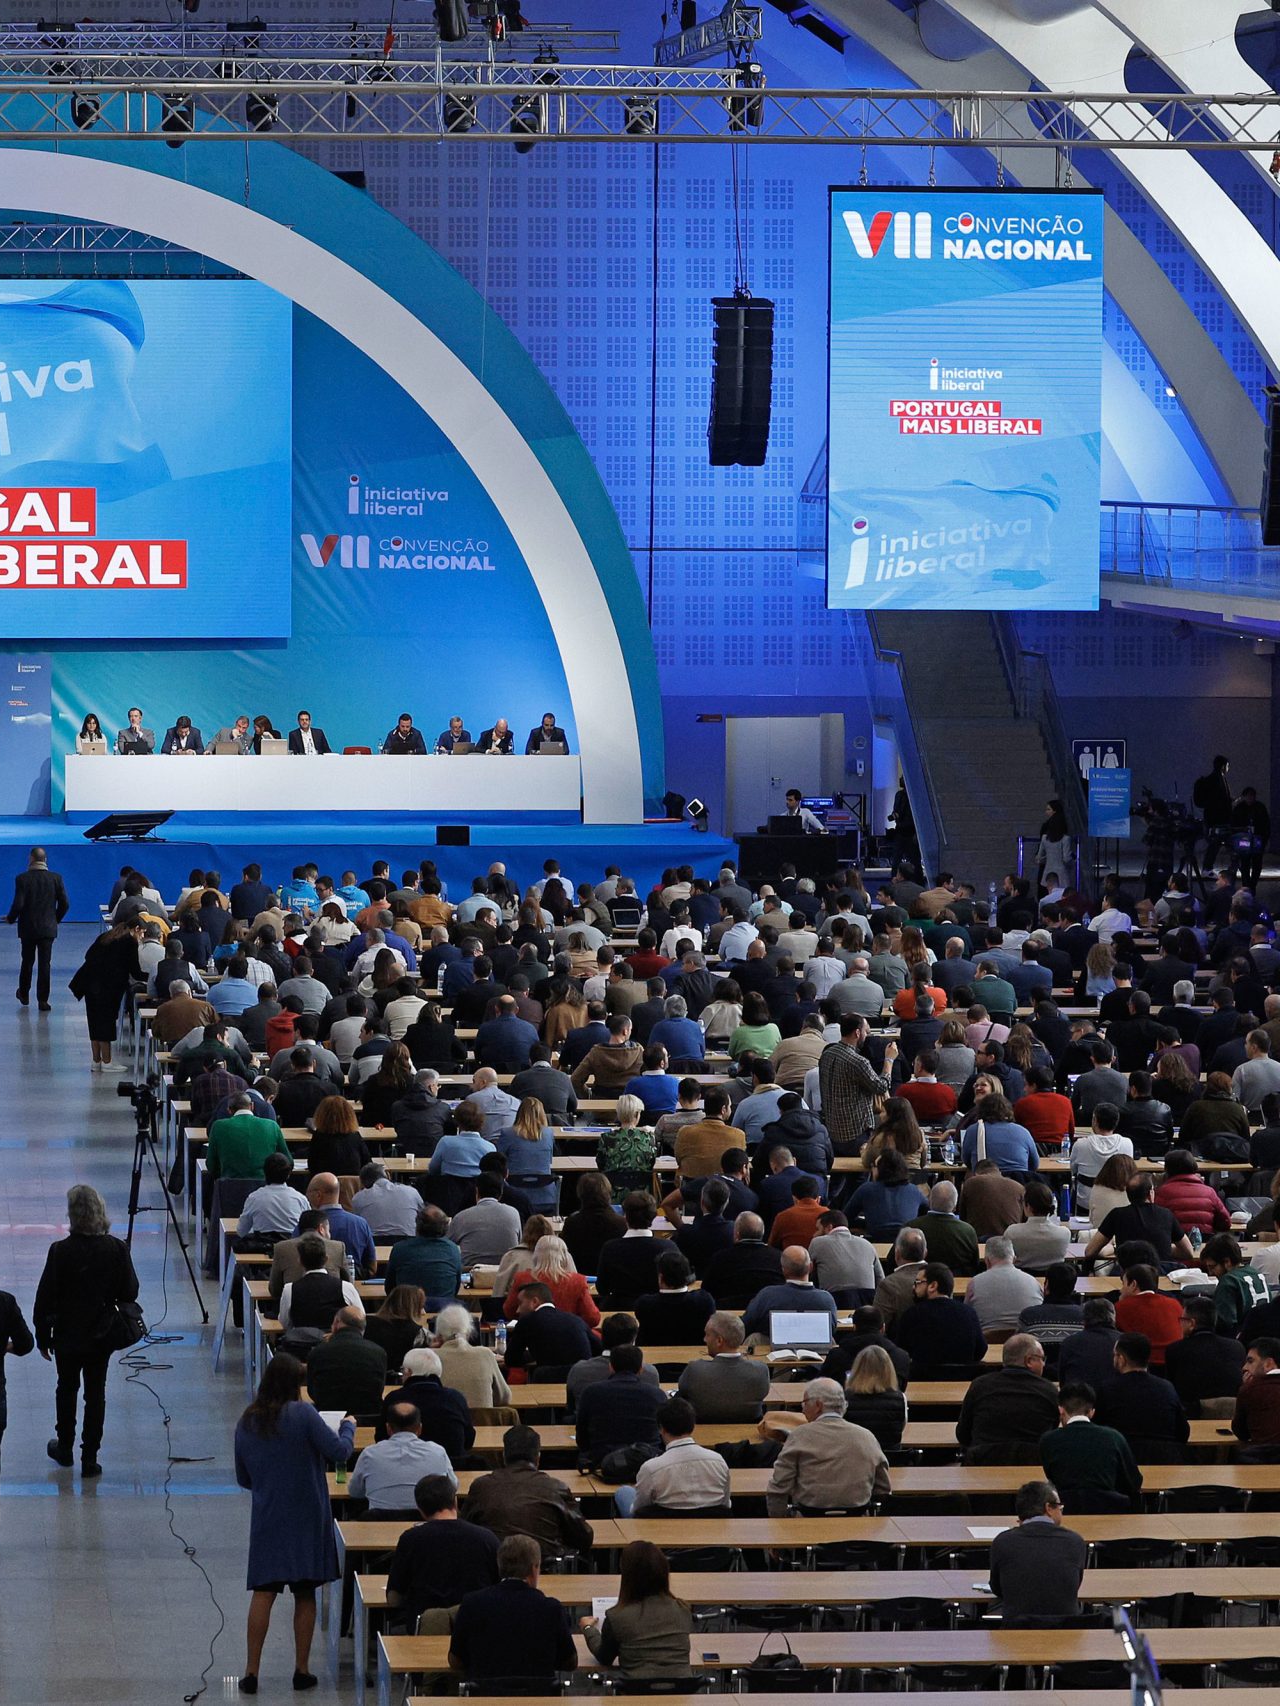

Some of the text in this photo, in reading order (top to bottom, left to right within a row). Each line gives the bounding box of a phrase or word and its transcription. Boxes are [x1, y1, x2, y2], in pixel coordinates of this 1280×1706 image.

[943, 212, 1084, 237] CONVENÇÃO
[842, 210, 932, 259] VII
[943, 238, 1092, 261] NACIONAL
[942, 368, 1003, 379] iniciativa
[942, 380, 985, 391] liberal
[893, 402, 1000, 416] PORTUGAL
[903, 419, 1039, 434] MAIS LIBERAL
[365, 487, 449, 501] iniciativa
[365, 502, 423, 516] liberal
[379, 536, 489, 554] CONVENÇÃO
[880, 518, 1032, 556] iniciativa
[300, 534, 370, 569] VII
[379, 555, 496, 571] NACIONAL
[875, 544, 986, 582] liberal
